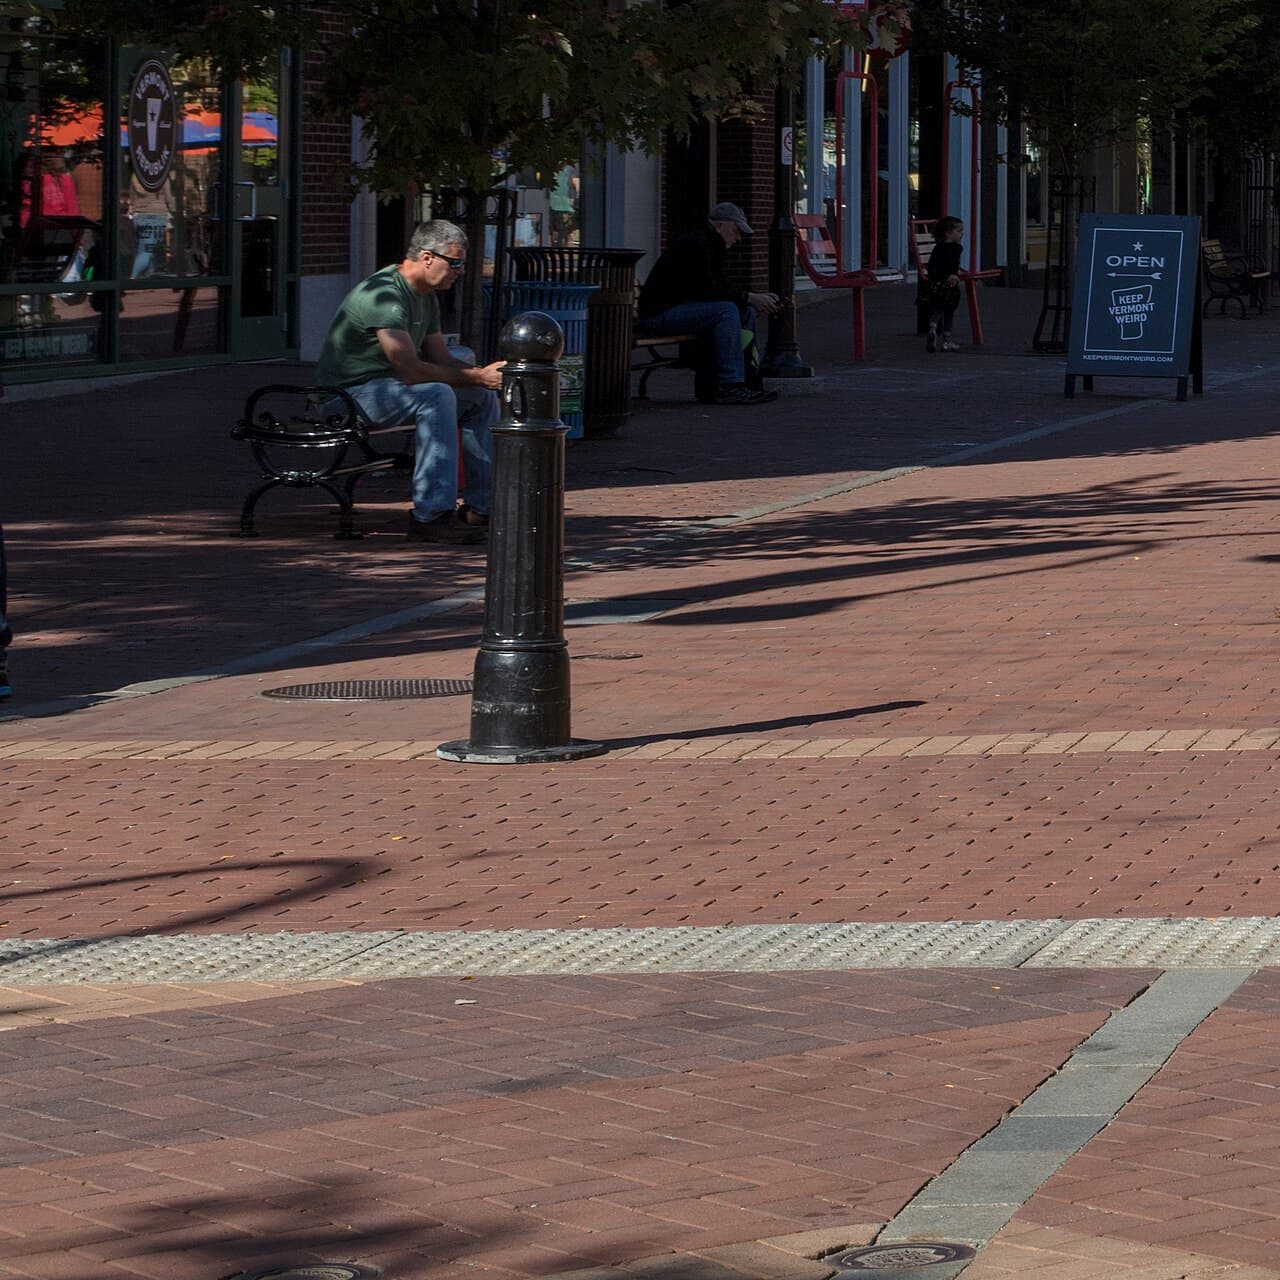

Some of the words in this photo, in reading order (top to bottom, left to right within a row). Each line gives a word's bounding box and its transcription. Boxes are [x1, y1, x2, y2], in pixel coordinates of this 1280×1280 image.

[1106, 255, 1164, 268] OPEN
[1119, 294, 1144, 305] KEEP
[1108, 302, 1155, 316] VERMONT
[1115, 313, 1147, 325] WEIRD
